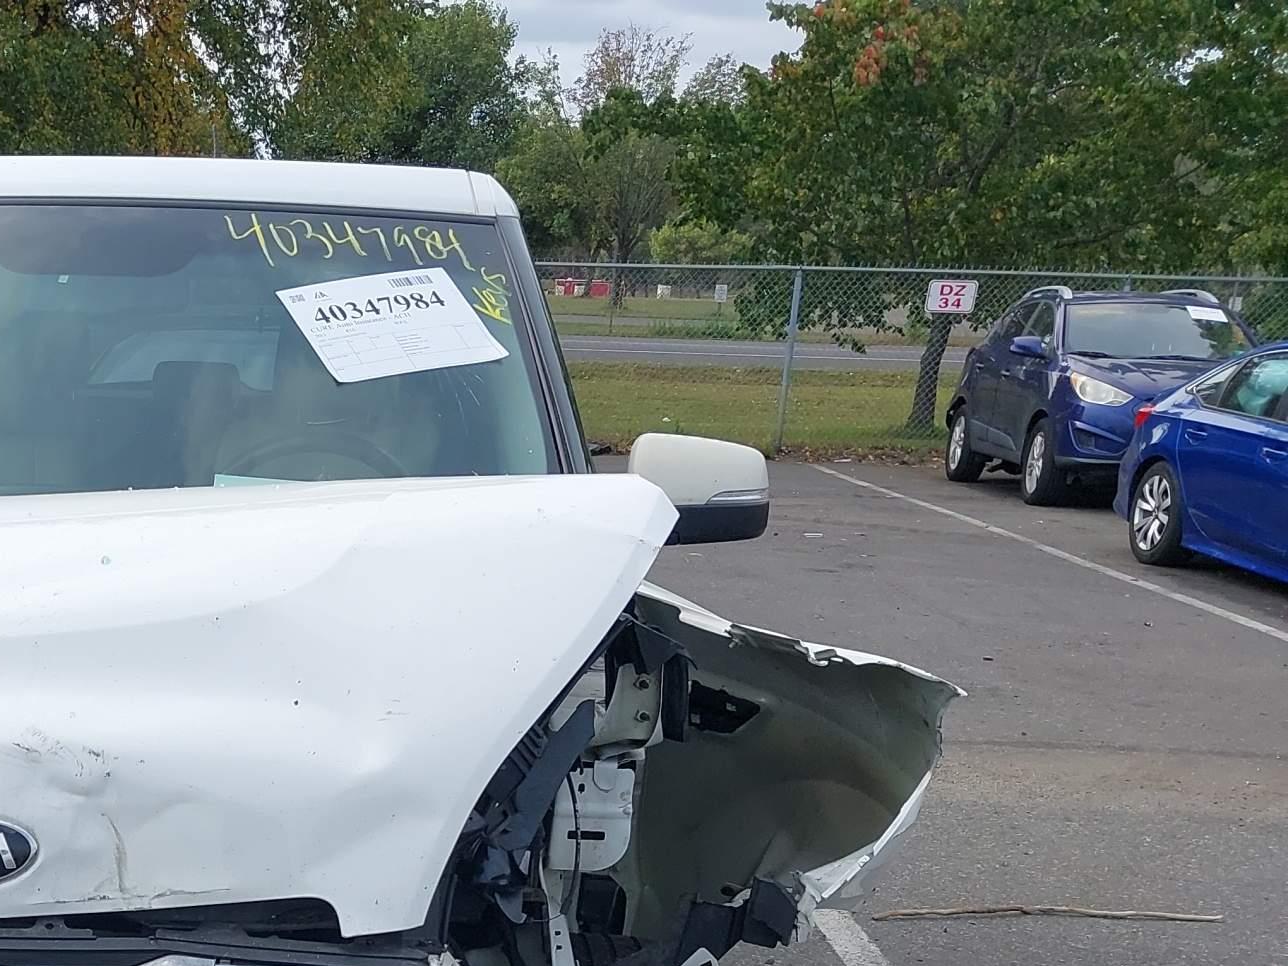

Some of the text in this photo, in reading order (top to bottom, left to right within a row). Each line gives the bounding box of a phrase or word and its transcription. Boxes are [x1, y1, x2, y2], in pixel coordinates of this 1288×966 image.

[224, 213, 476, 271] 40347984
[939, 284, 968, 297] DZ
[314, 290, 446, 324] 40347984
[938, 297, 962, 309] 34
